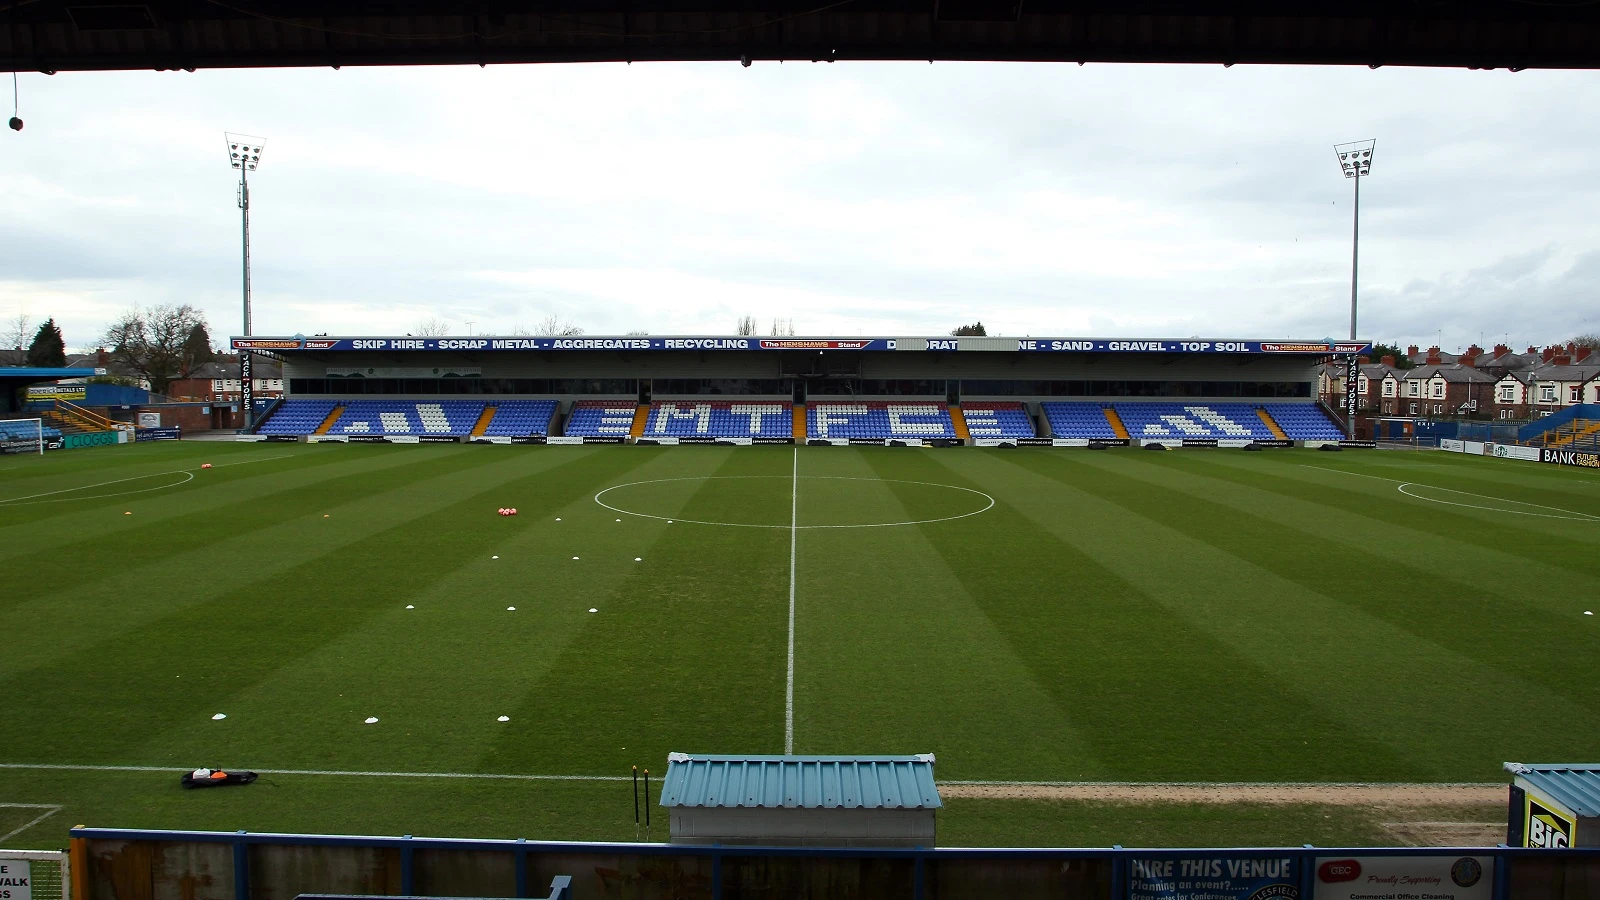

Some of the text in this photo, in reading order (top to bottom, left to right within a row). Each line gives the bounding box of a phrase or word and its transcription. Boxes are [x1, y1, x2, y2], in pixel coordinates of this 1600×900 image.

[352, 340, 386, 349] SKIP
[391, 340, 425, 349] HIRE
[438, 340, 488, 349] SCRAP
[492, 340, 539, 349] METAL
[552, 340, 650, 349] AGGREGATES
[664, 340, 748, 349] RECYCLING
[1018, 341, 1037, 350] NE
[1051, 341, 1093, 350] SAND
[1108, 342, 1166, 351] GRAVEL
[1180, 342, 1210, 351] TOP
[1215, 342, 1250, 352] SOIL
[72, 433, 113, 447] CLOGGS
[1544, 450, 1576, 464] BANK
[1131, 859, 1290, 878] HIRE THIS VENUE
[1330, 866, 1352, 875] GEC
[1131, 880, 1175, 892] Planning
[1179, 881, 1192, 889] an
[1368, 876, 1441, 886] Proudly Supporting
